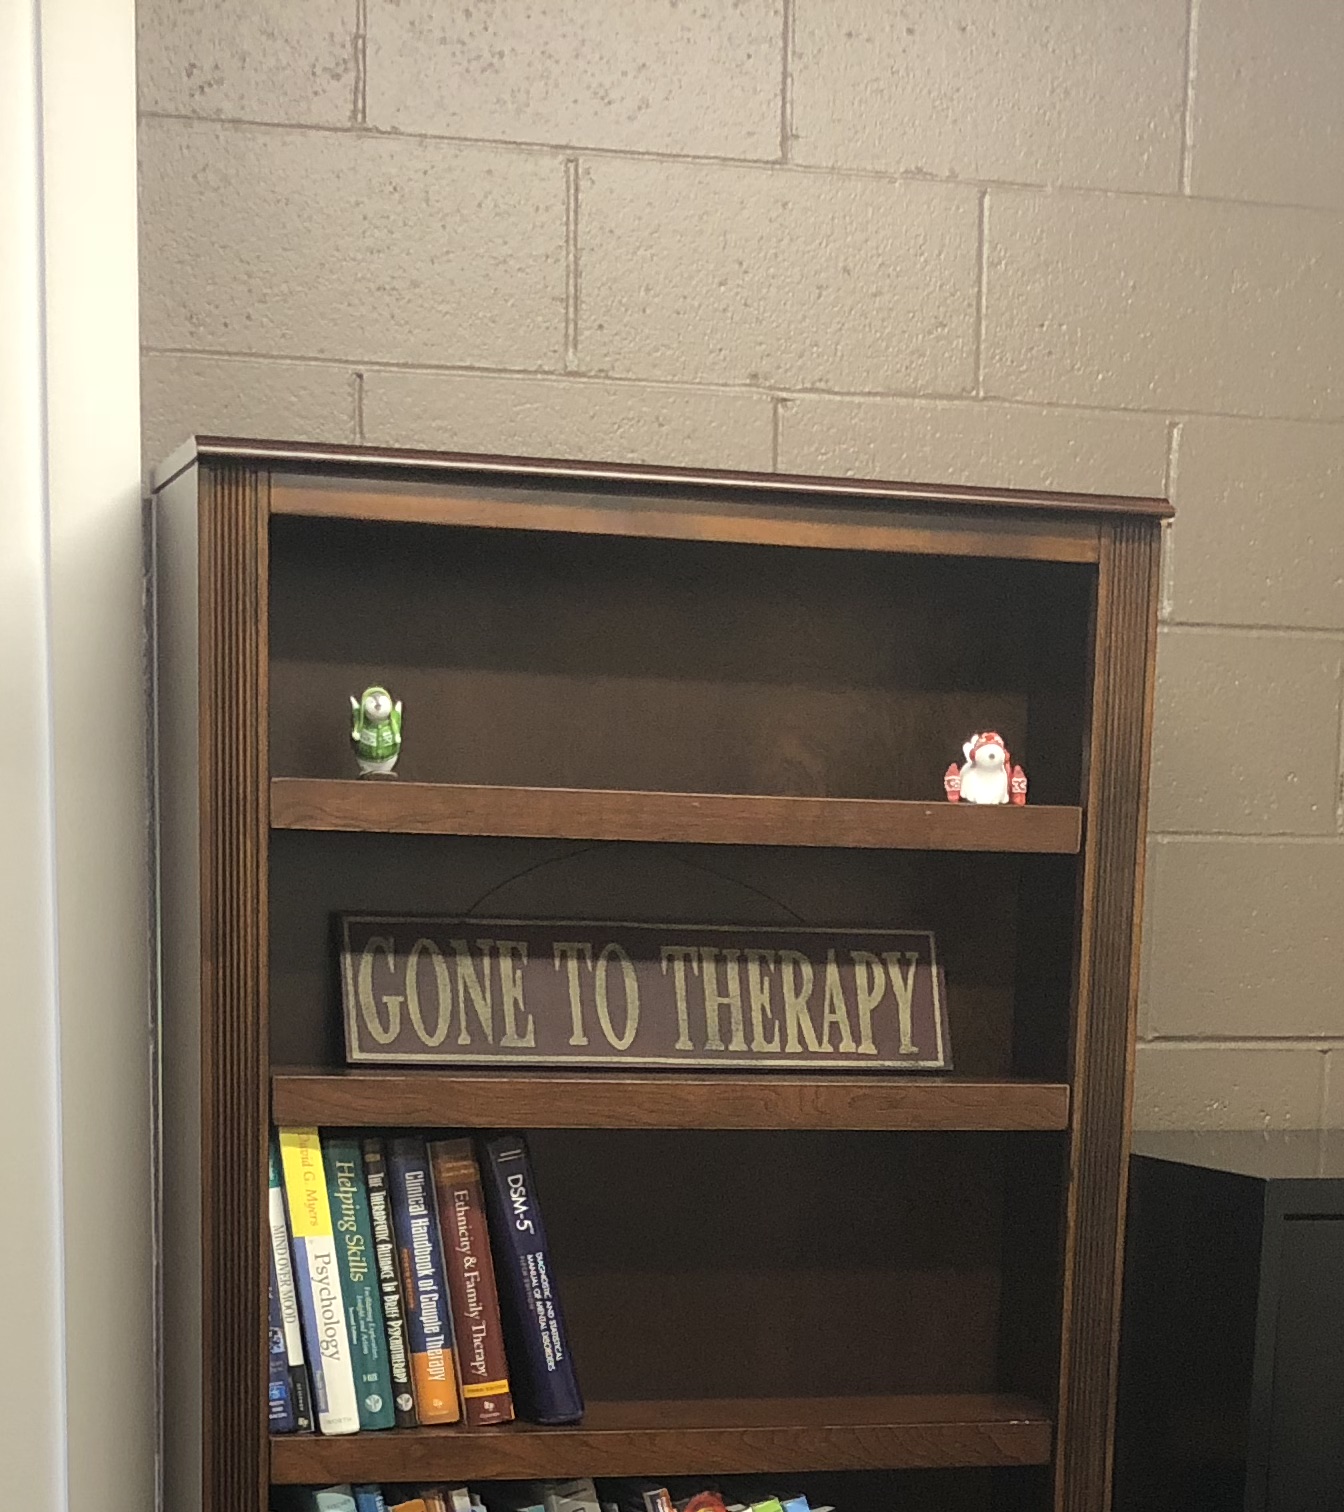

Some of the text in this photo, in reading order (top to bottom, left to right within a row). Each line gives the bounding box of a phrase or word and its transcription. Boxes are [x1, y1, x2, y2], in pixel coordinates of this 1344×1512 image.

[357, 935, 920, 1055] GONE TO THERAPY
[302, 1170, 315, 1182] G.
[304, 1188, 320, 1226] Myers
[505, 1173, 533, 1233] DSM-5
[330, 1159, 368, 1282] Helping Skills
[449, 1189, 475, 1255] Ethnicity
[272, 1224, 296, 1323] MIND OVER MOOD
[404, 1170, 448, 1382] Clinical Handbook of Couple Therapy
[460, 1270, 484, 1320] Family
[463, 1255, 477, 1269] &
[308, 1252, 344, 1362] Psychology
[525, 1253, 556, 1371] MANUAL OF MENTAL DISORDERS
[534, 1251, 563, 1361] DIAGNOSTIC AND STATISTICAL
[465, 1320, 492, 1377] Therapy
